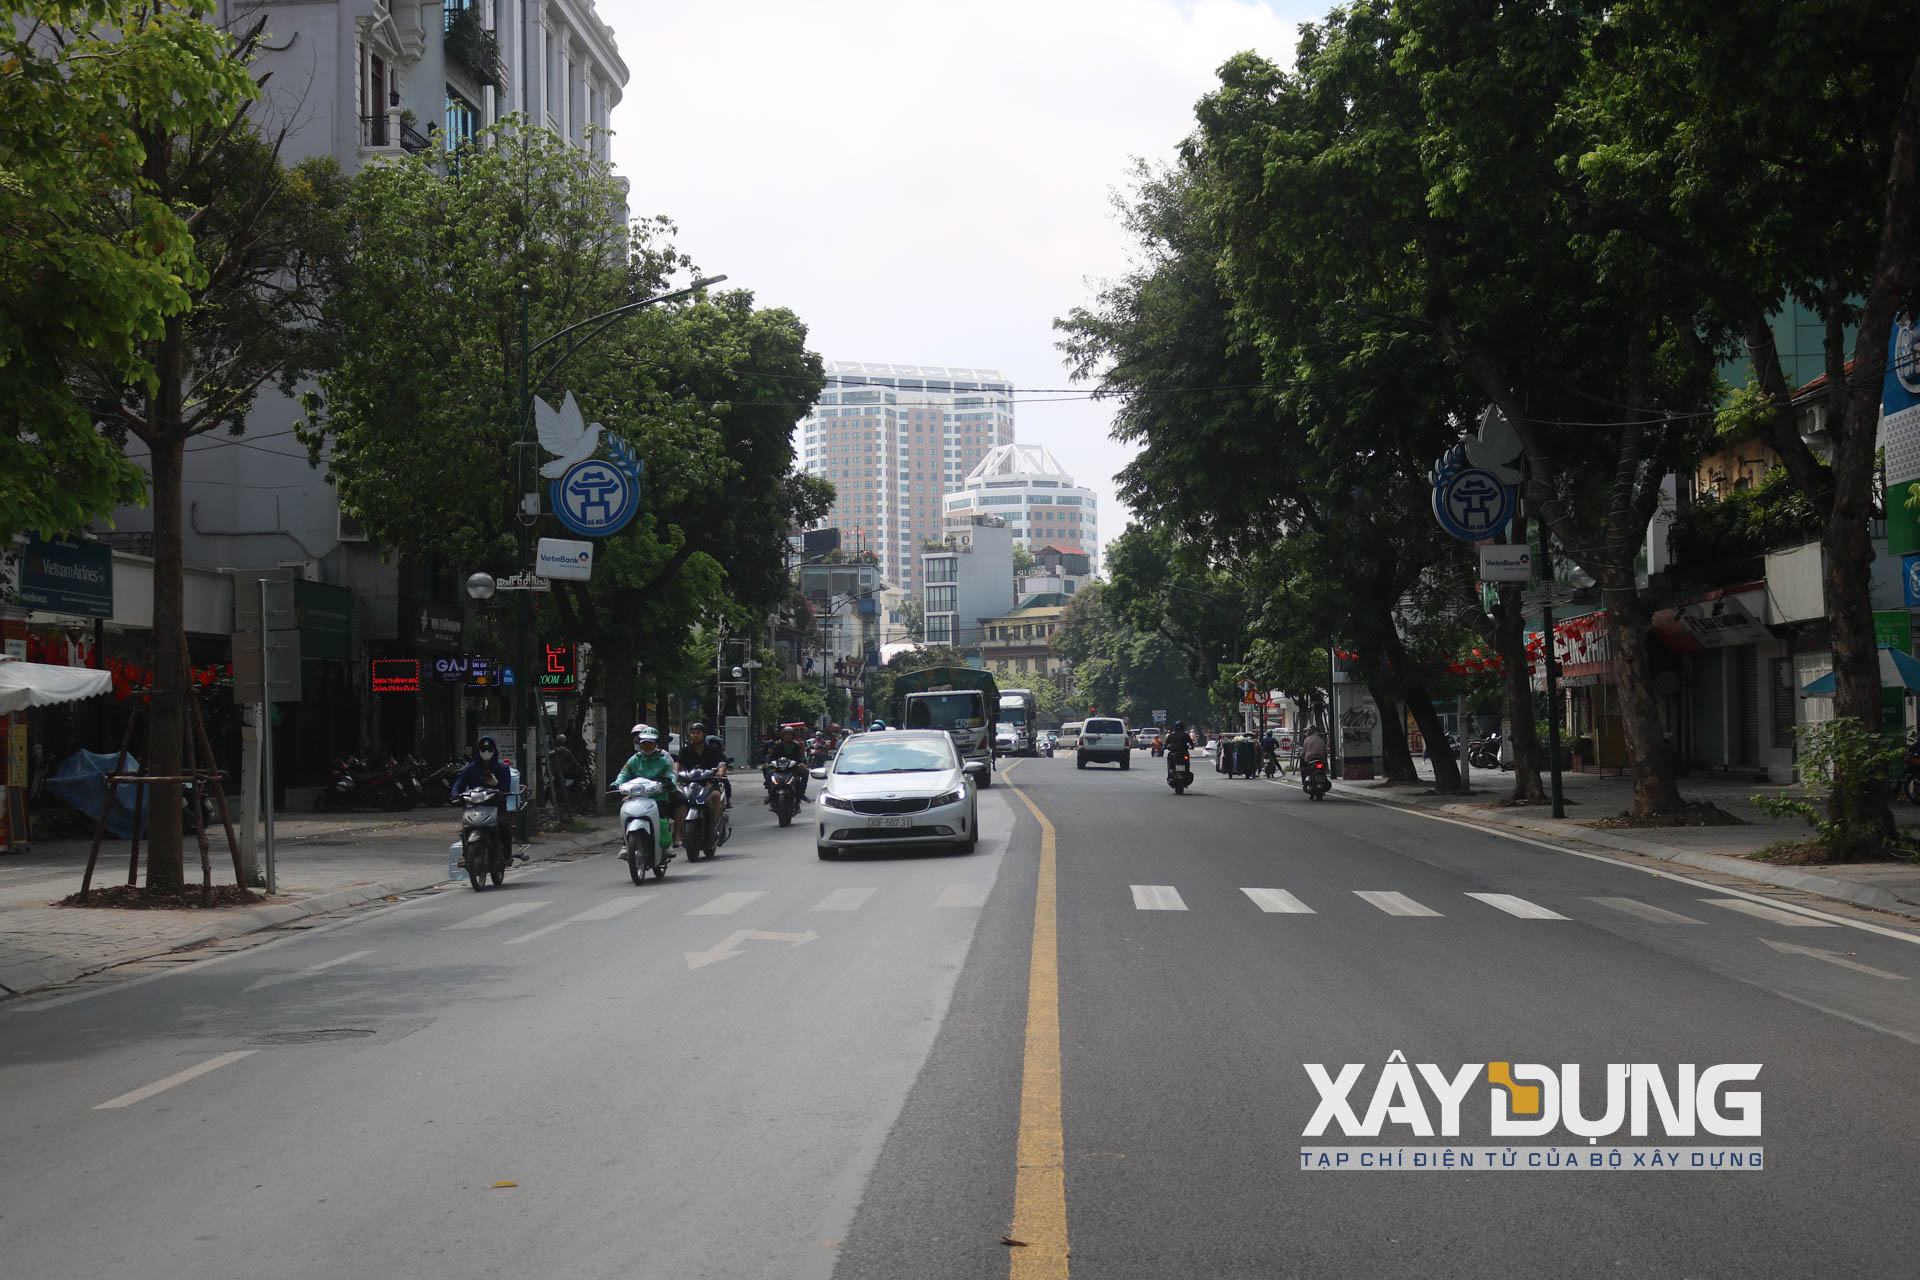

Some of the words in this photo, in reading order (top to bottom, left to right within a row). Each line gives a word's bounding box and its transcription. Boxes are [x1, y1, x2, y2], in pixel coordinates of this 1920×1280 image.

[540, 554, 579, 564] VietinBank
[1485, 559, 1521, 567] VietinBank
[435, 658, 468, 673] GAJ
